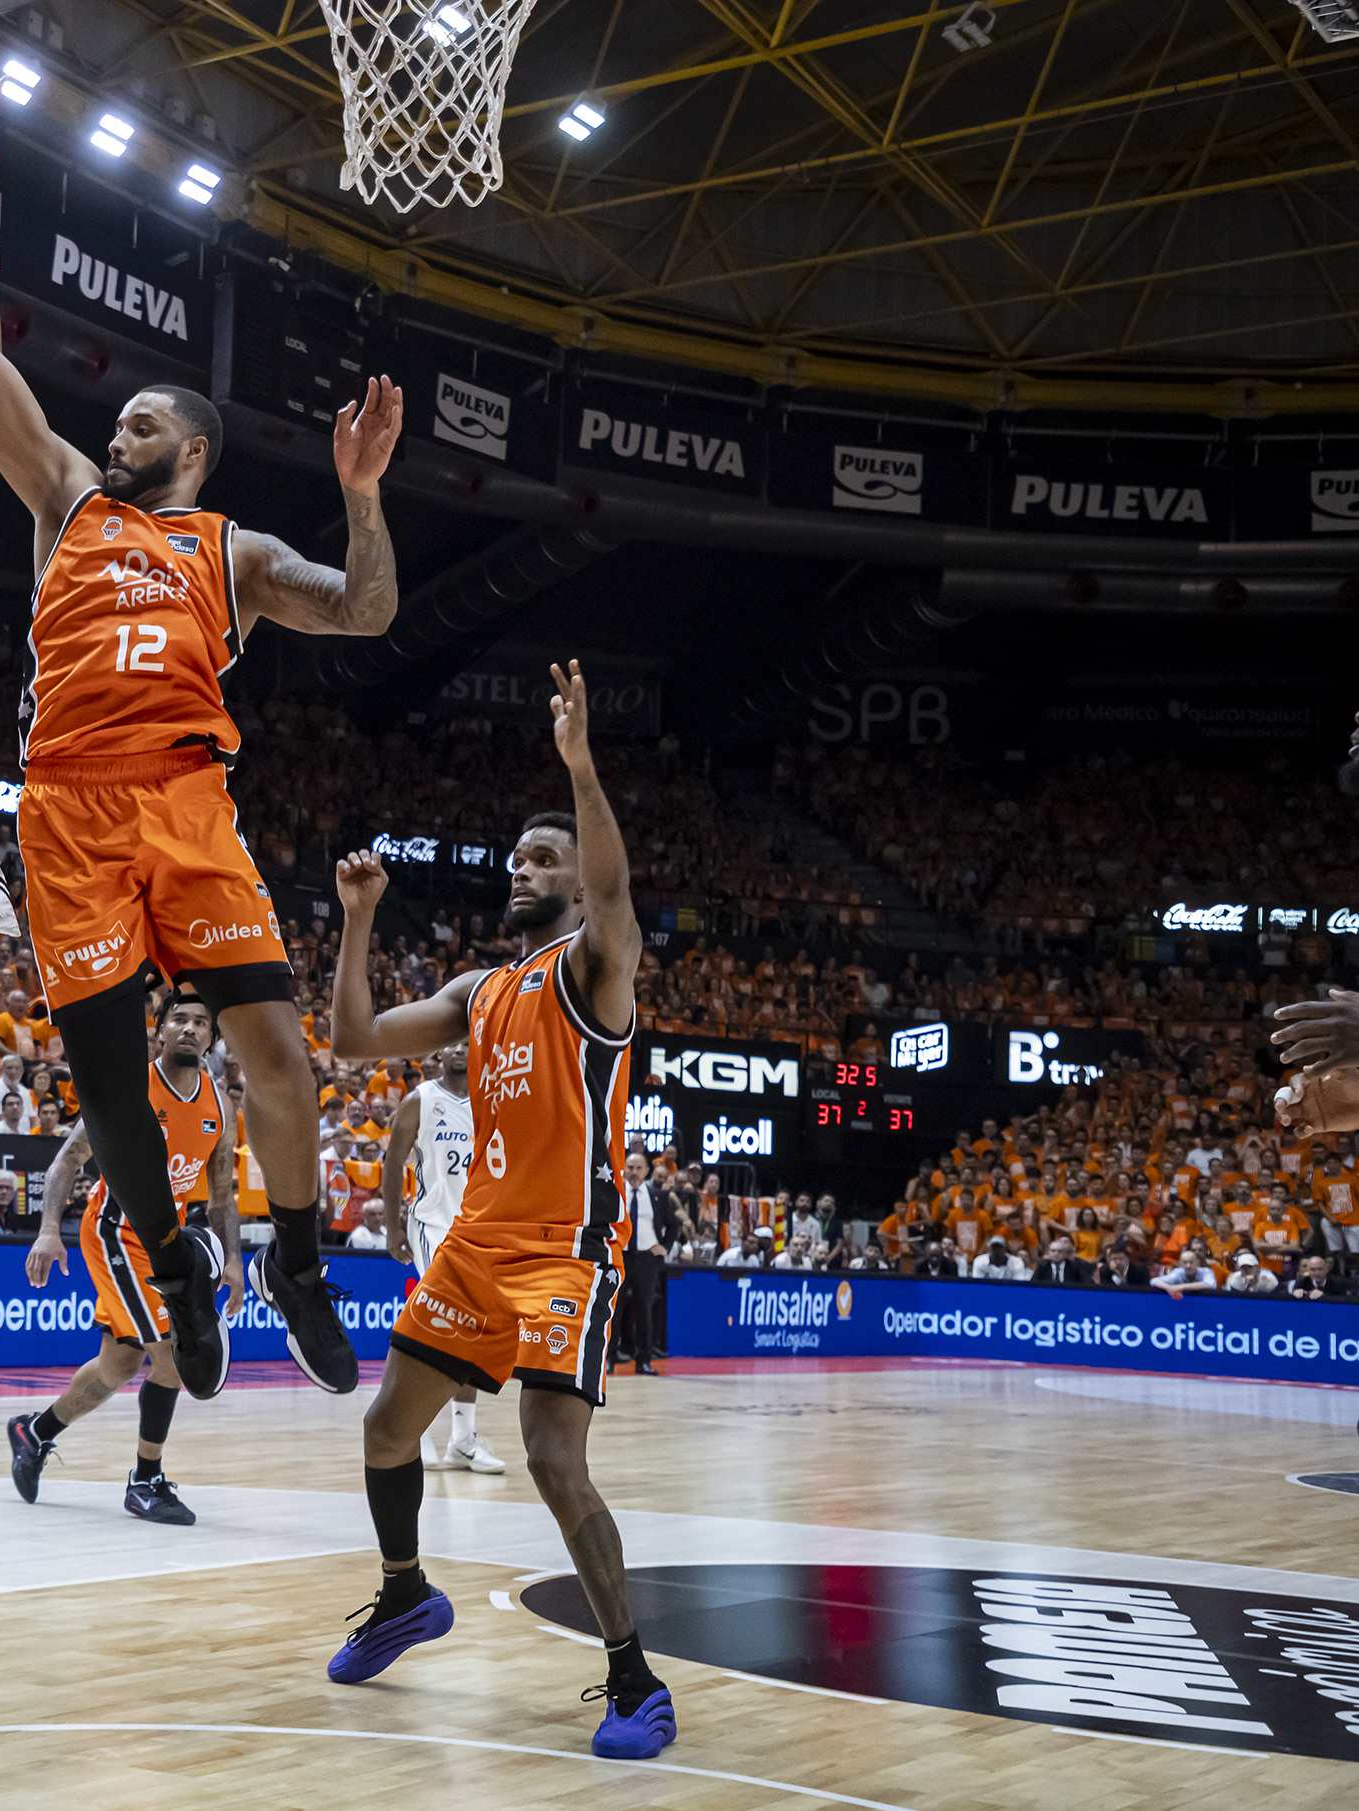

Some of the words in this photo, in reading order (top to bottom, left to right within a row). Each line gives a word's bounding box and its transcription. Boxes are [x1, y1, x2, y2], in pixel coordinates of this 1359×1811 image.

[51, 233, 189, 342] PULEVA
[441, 382, 506, 423] PULEVA
[579, 407, 745, 479] PULEVA
[840, 453, 919, 480] PULEVA
[1011, 474, 1209, 523] PULEVA
[115, 624, 168, 672] 12
[807, 682, 952, 746] SPB
[650, 1047, 799, 1097] KGM
[811, 1088, 841, 1101] LOCAL
[817, 1103, 842, 1126] 37
[857, 1100, 867, 1116] 2
[889, 1108, 914, 1130] 37
[702, 1115, 773, 1165] gicoll
[415, 1290, 478, 1330] PULEVA
[553, 1302, 571, 1314] acb
[737, 1277, 834, 1328] Transaher
[753, 1329, 782, 1349] Smart
[883, 1306, 998, 1339] Operador
[1005, 1313, 1143, 1348] logístico
[1150, 1321, 1259, 1355] oficial
[1268, 1330, 1320, 1359] de
[971, 1577, 1275, 1737] PAMESA
